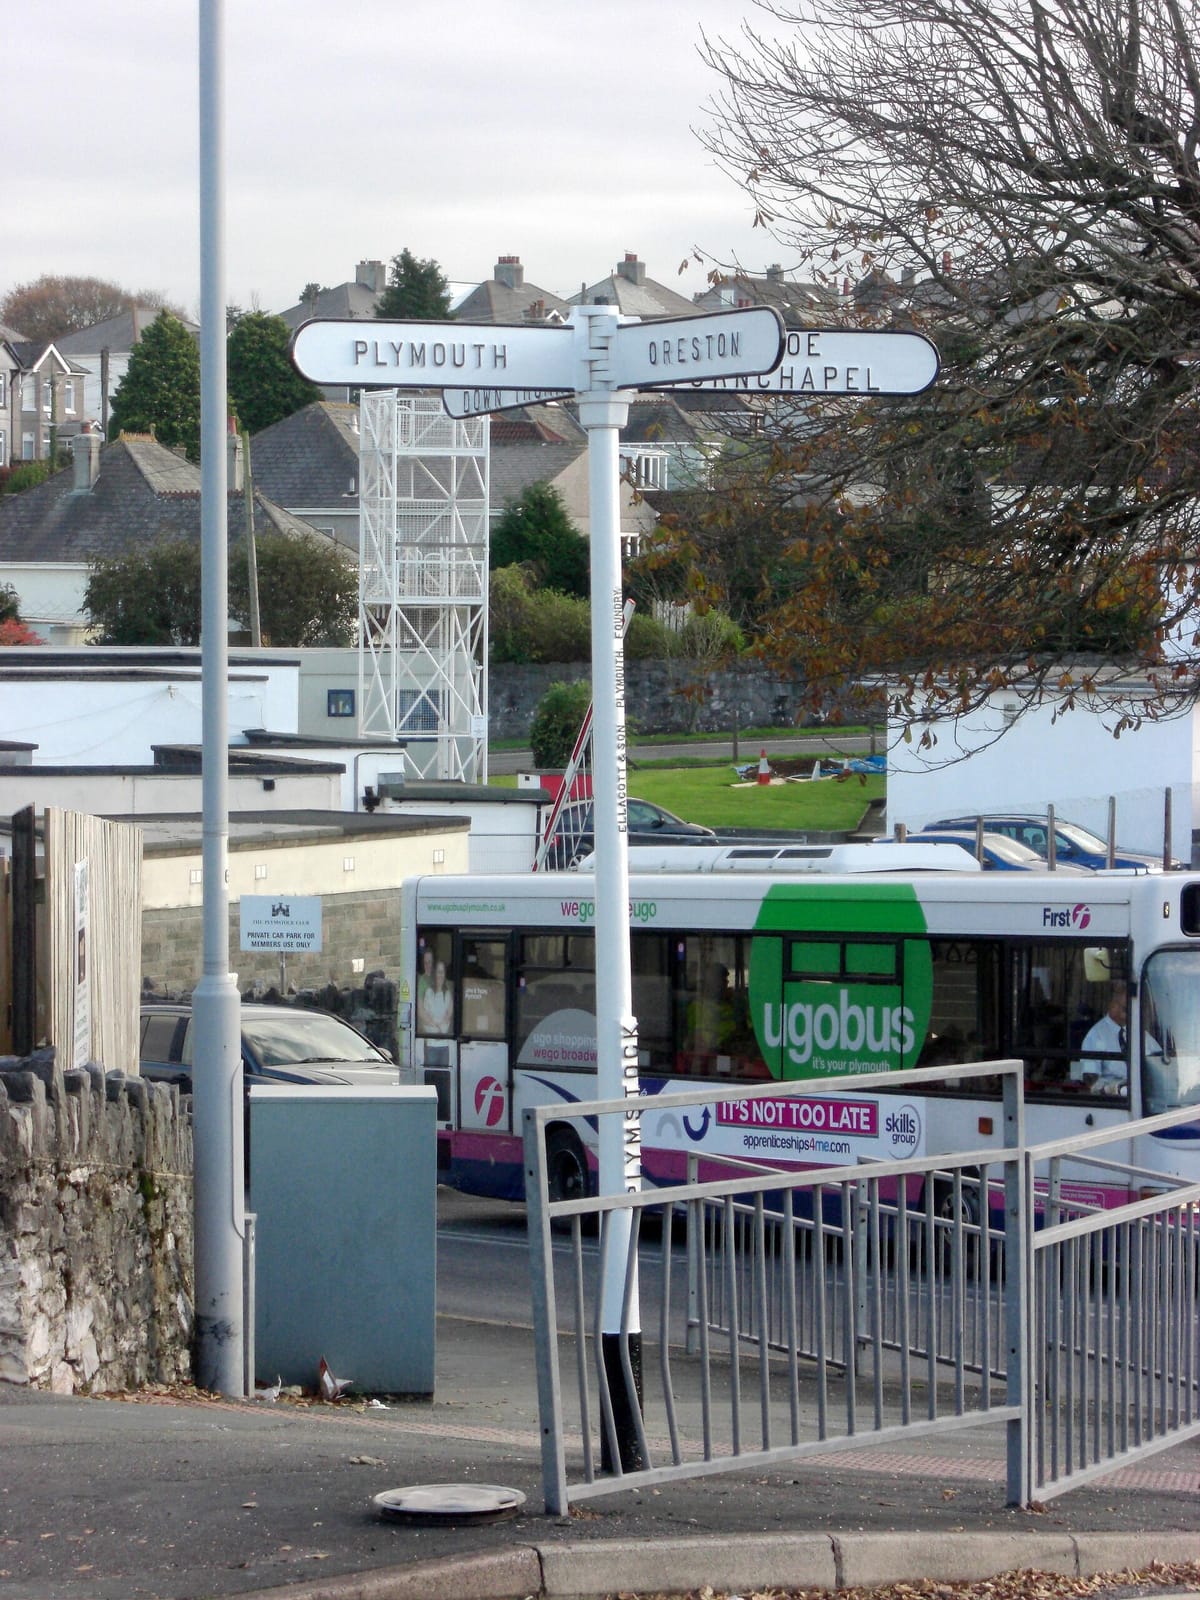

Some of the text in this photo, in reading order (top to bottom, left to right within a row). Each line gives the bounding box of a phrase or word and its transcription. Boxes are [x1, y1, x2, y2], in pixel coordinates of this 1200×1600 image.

[353, 339, 508, 369] PLYMOUTH
[649, 331, 740, 365] ORESTON
[787, 333, 821, 356] OE
[463, 389, 502, 413] DOWN
[616, 724, 626, 750] SON
[617, 754, 626, 762] &
[617, 767, 627, 832] ELLACOTT
[561, 902, 595, 922] wego
[1043, 907, 1071, 927] First
[764, 989, 915, 1064] ugobus
[533, 1048, 598, 1061] wego broadw
[813, 1057, 891, 1074] it's your plymouth
[722, 1100, 871, 1131] IT'S NOT TOO LATE
[885, 1112, 916, 1134] skills
[743, 1133, 851, 1154] apprenticeships4me.com
[892, 1133, 916, 1146] group
